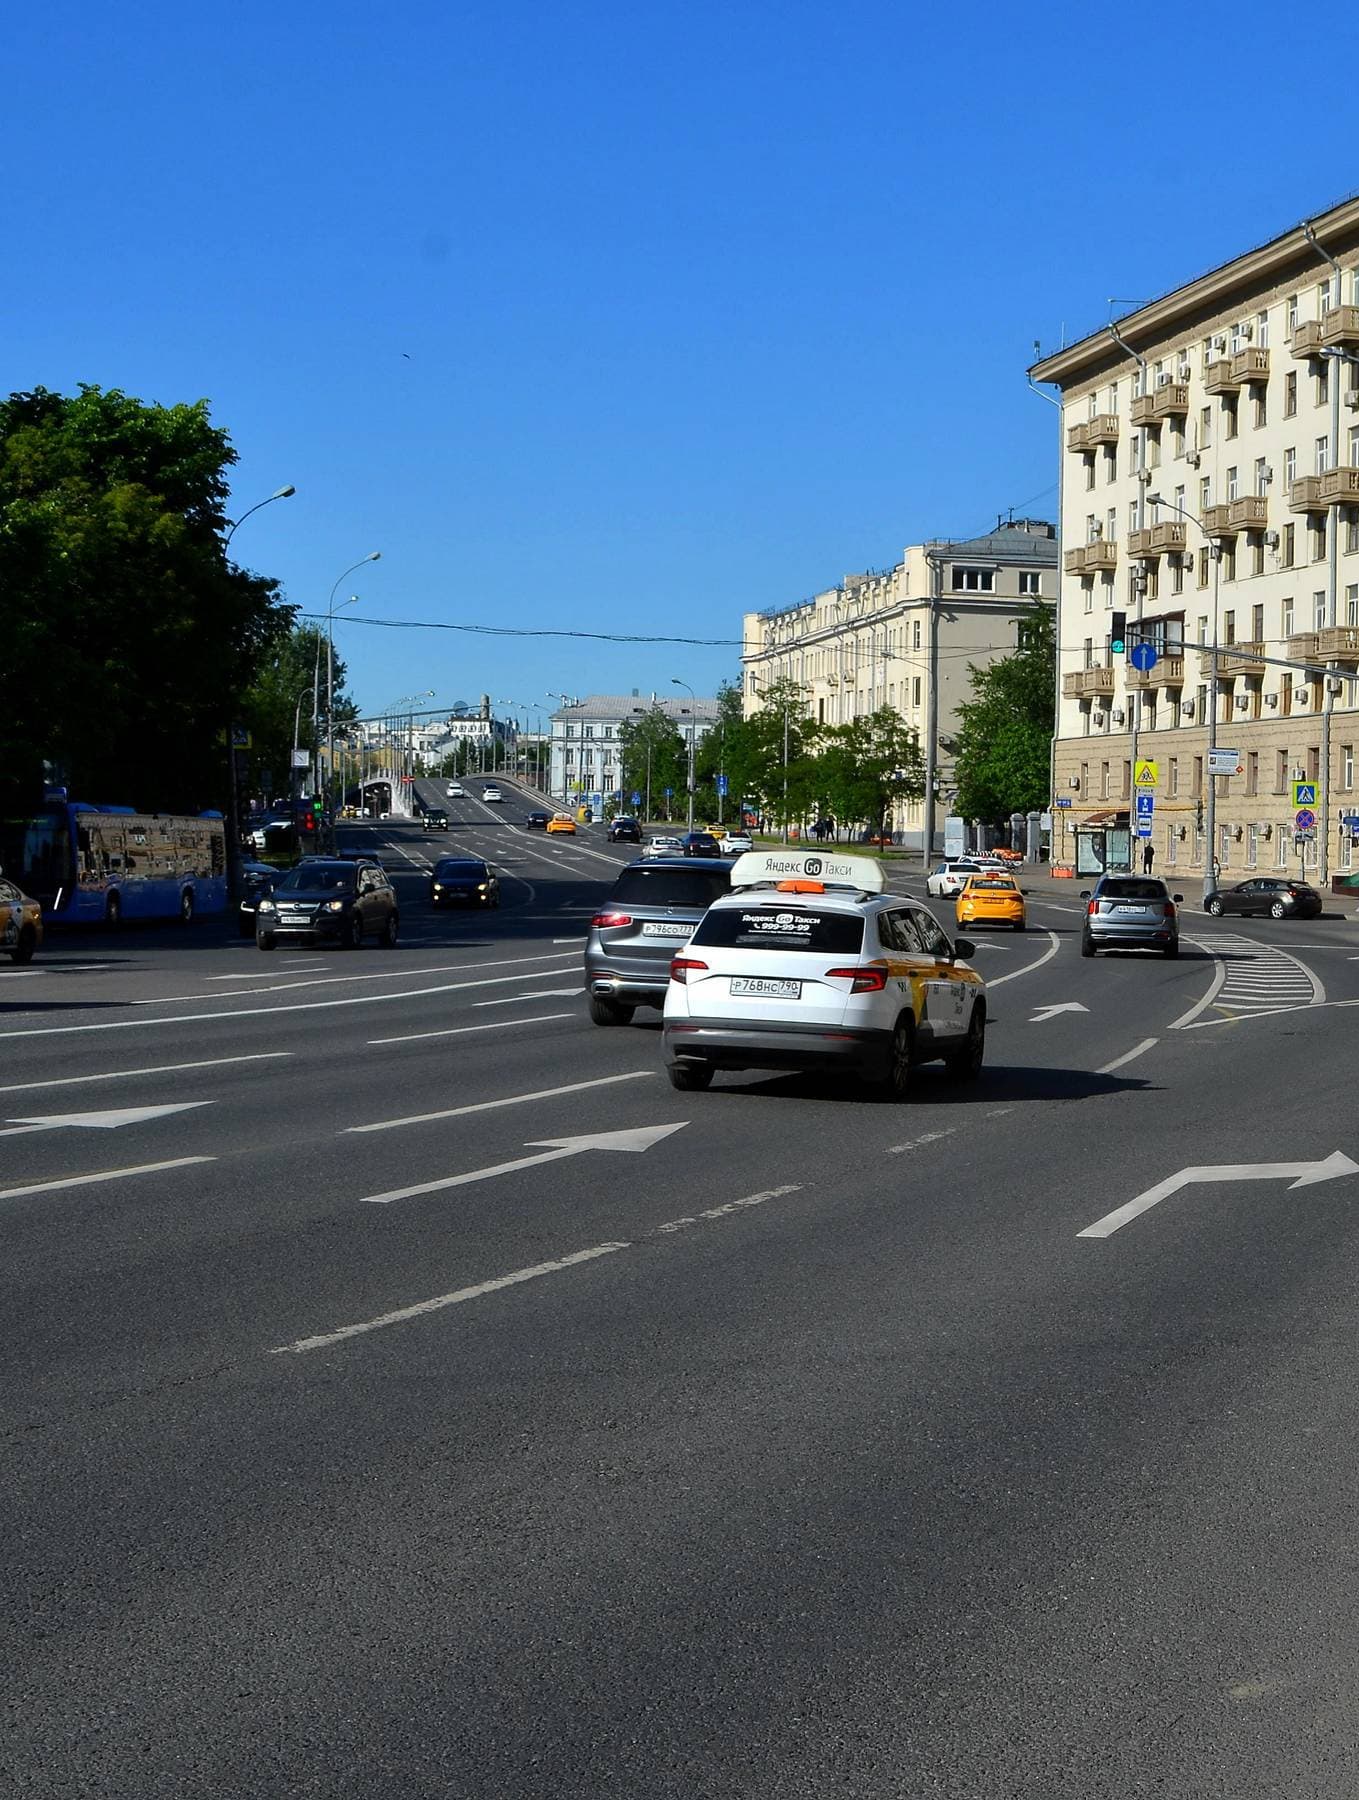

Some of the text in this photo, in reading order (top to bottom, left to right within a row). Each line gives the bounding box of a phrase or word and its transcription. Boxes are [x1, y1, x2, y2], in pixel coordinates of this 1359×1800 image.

[765, 858, 852, 876] Яндекс Go Такси
